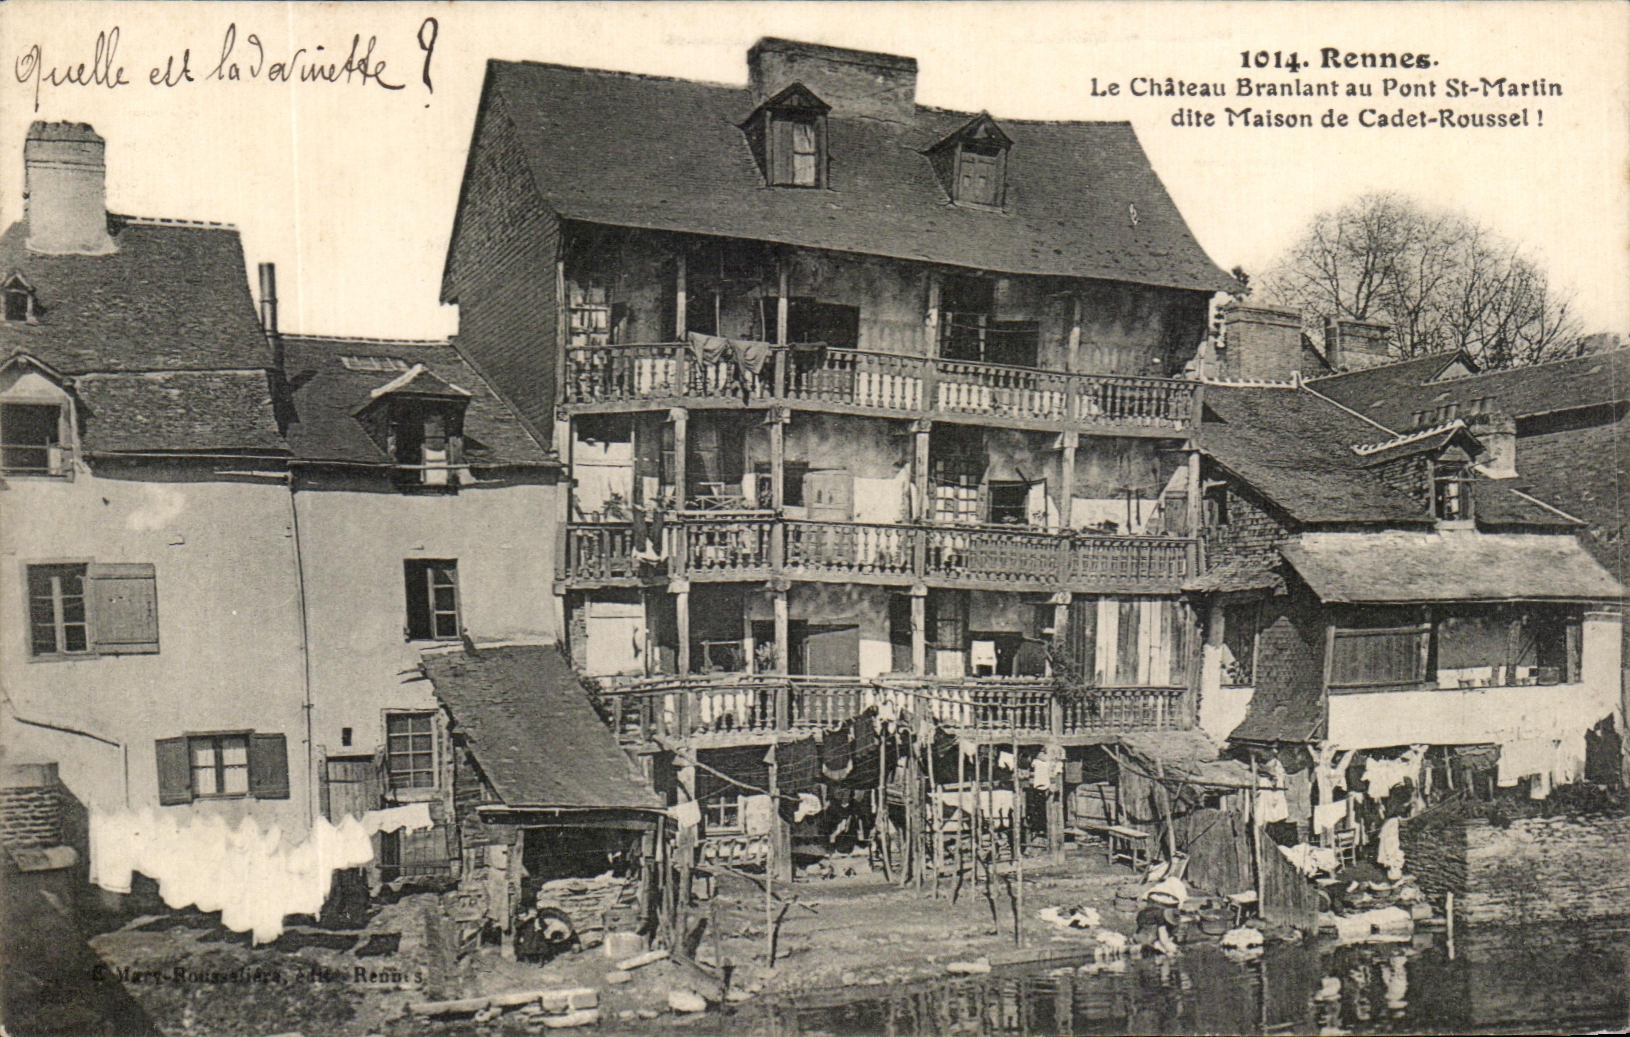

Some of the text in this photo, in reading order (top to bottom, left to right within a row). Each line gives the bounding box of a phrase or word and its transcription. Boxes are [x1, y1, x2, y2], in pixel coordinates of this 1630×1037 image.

[16, 26, 130, 112] Quelle
[150, 48, 195, 88] est
[206, 23, 240, 81] la
[416, 16, 439, 109] ?
